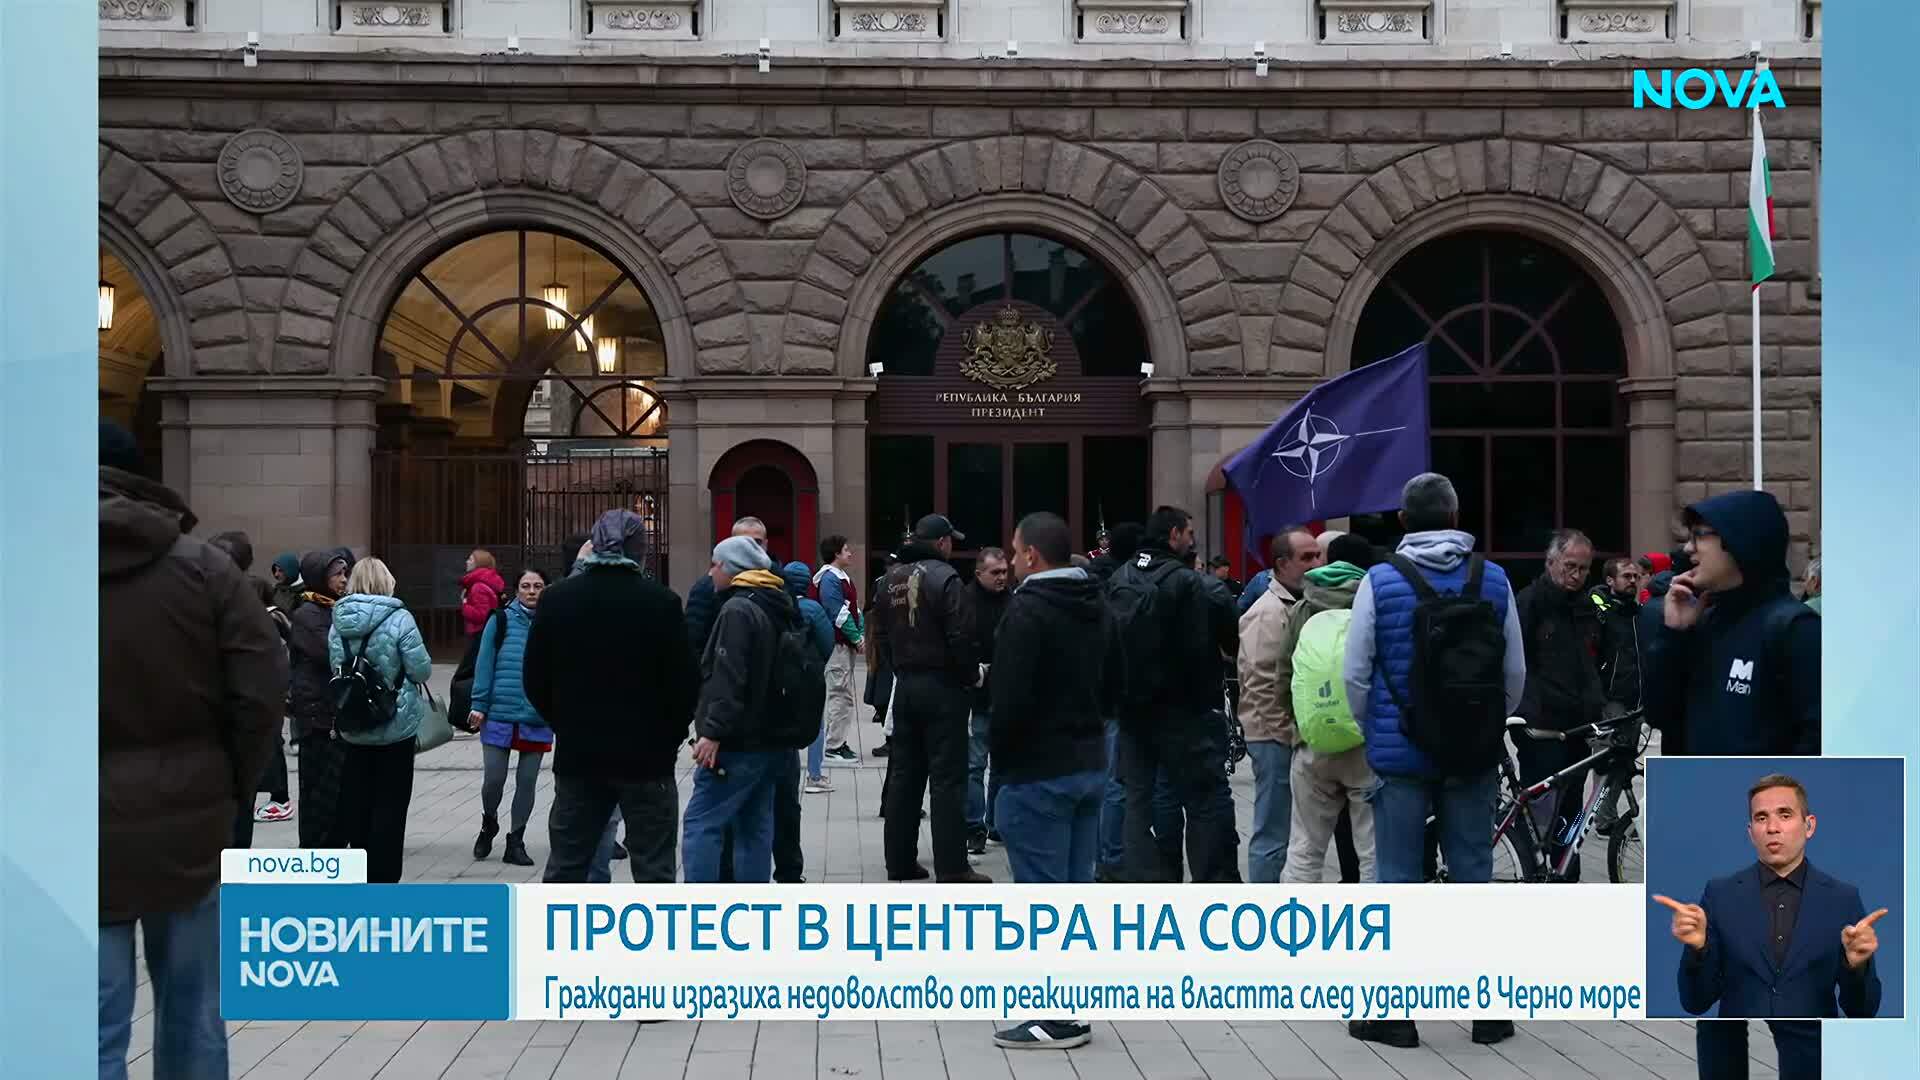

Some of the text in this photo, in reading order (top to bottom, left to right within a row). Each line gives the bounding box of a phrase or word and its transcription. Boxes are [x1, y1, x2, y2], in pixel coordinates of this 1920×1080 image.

[935, 392, 1081, 403] РЕПУБЛИКА БЪЛГАРИЯ
[971, 407, 1046, 420] ПРЕЗИДЕНТ
